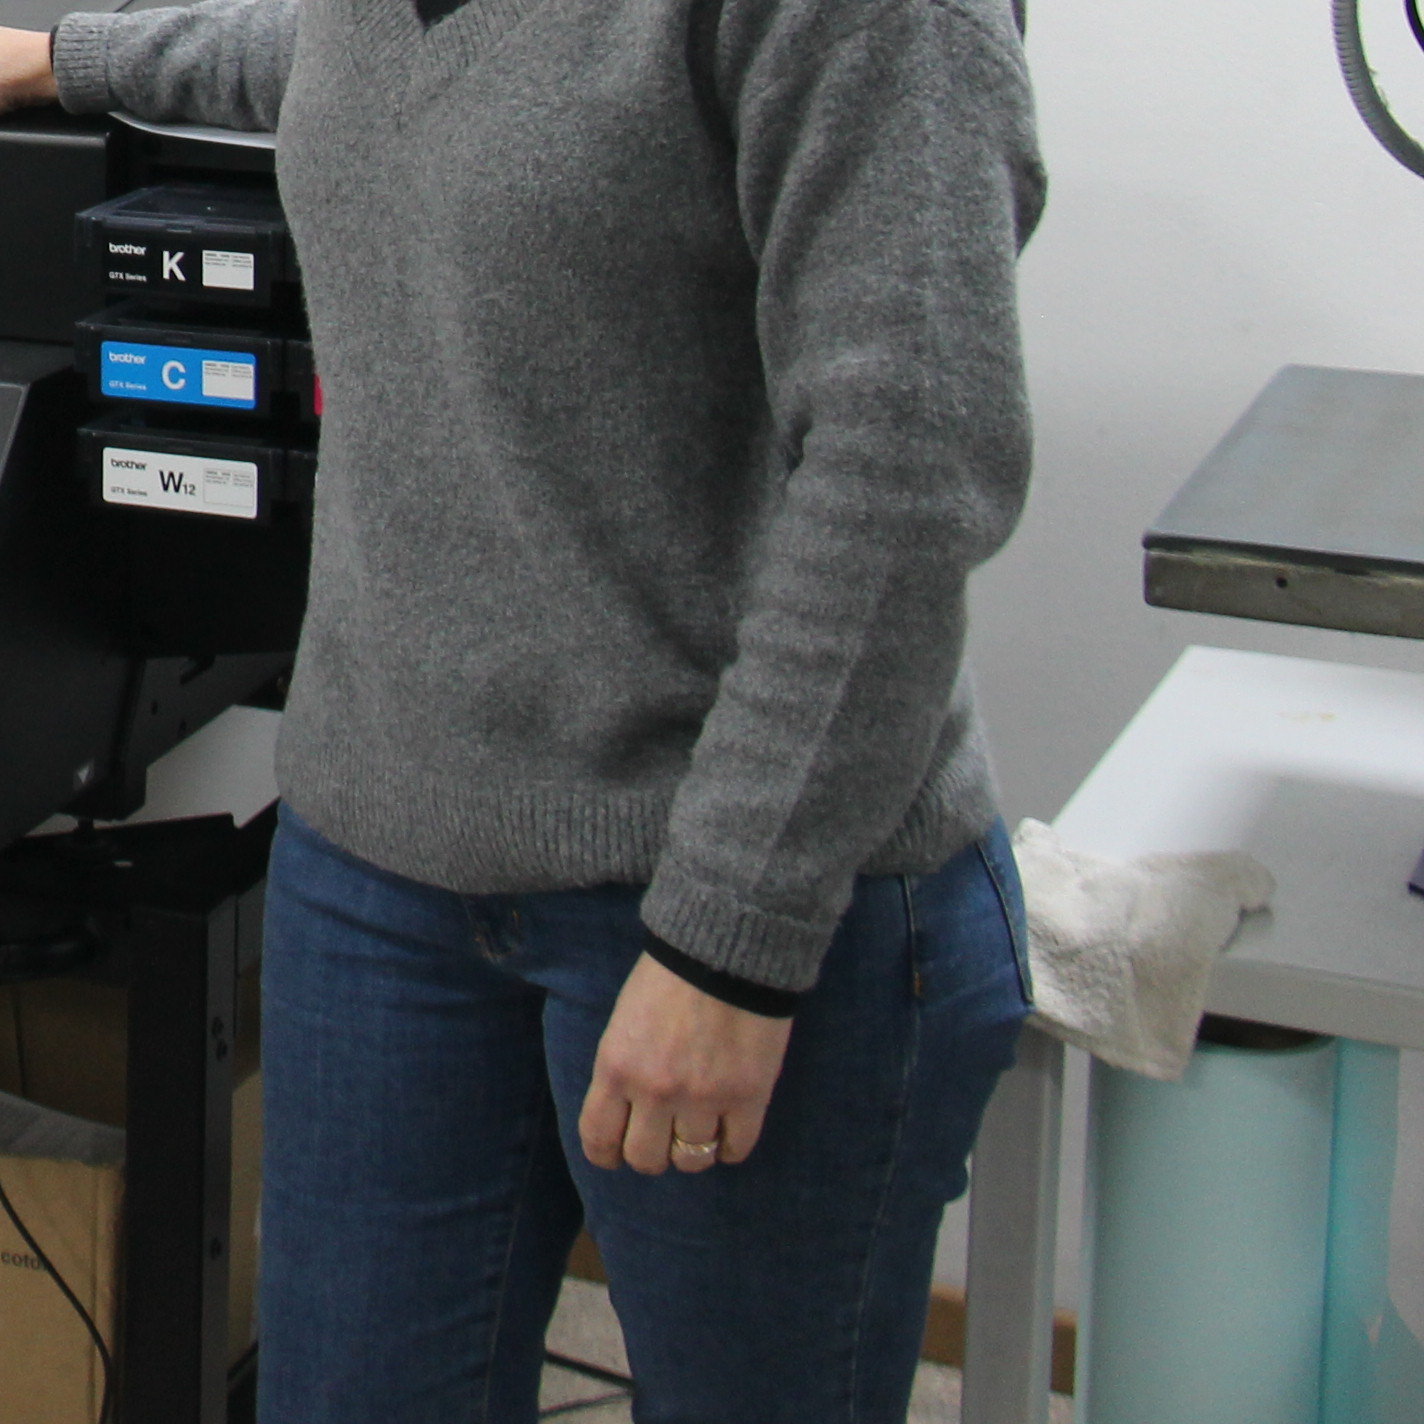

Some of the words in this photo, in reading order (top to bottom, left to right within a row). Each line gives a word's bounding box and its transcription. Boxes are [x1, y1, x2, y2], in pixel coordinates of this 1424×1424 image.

[109, 242, 147, 256] brother
[162, 250, 186, 282] K
[109, 271, 124, 281] GTX
[125, 272, 147, 282] Series
[109, 351, 147, 365] brother
[161, 360, 186, 390] C
[109, 380, 124, 389] GTX
[110, 458, 147, 471] brother
[110, 487, 125, 496] GTX
[1, 1250, 49, 1274] coto
